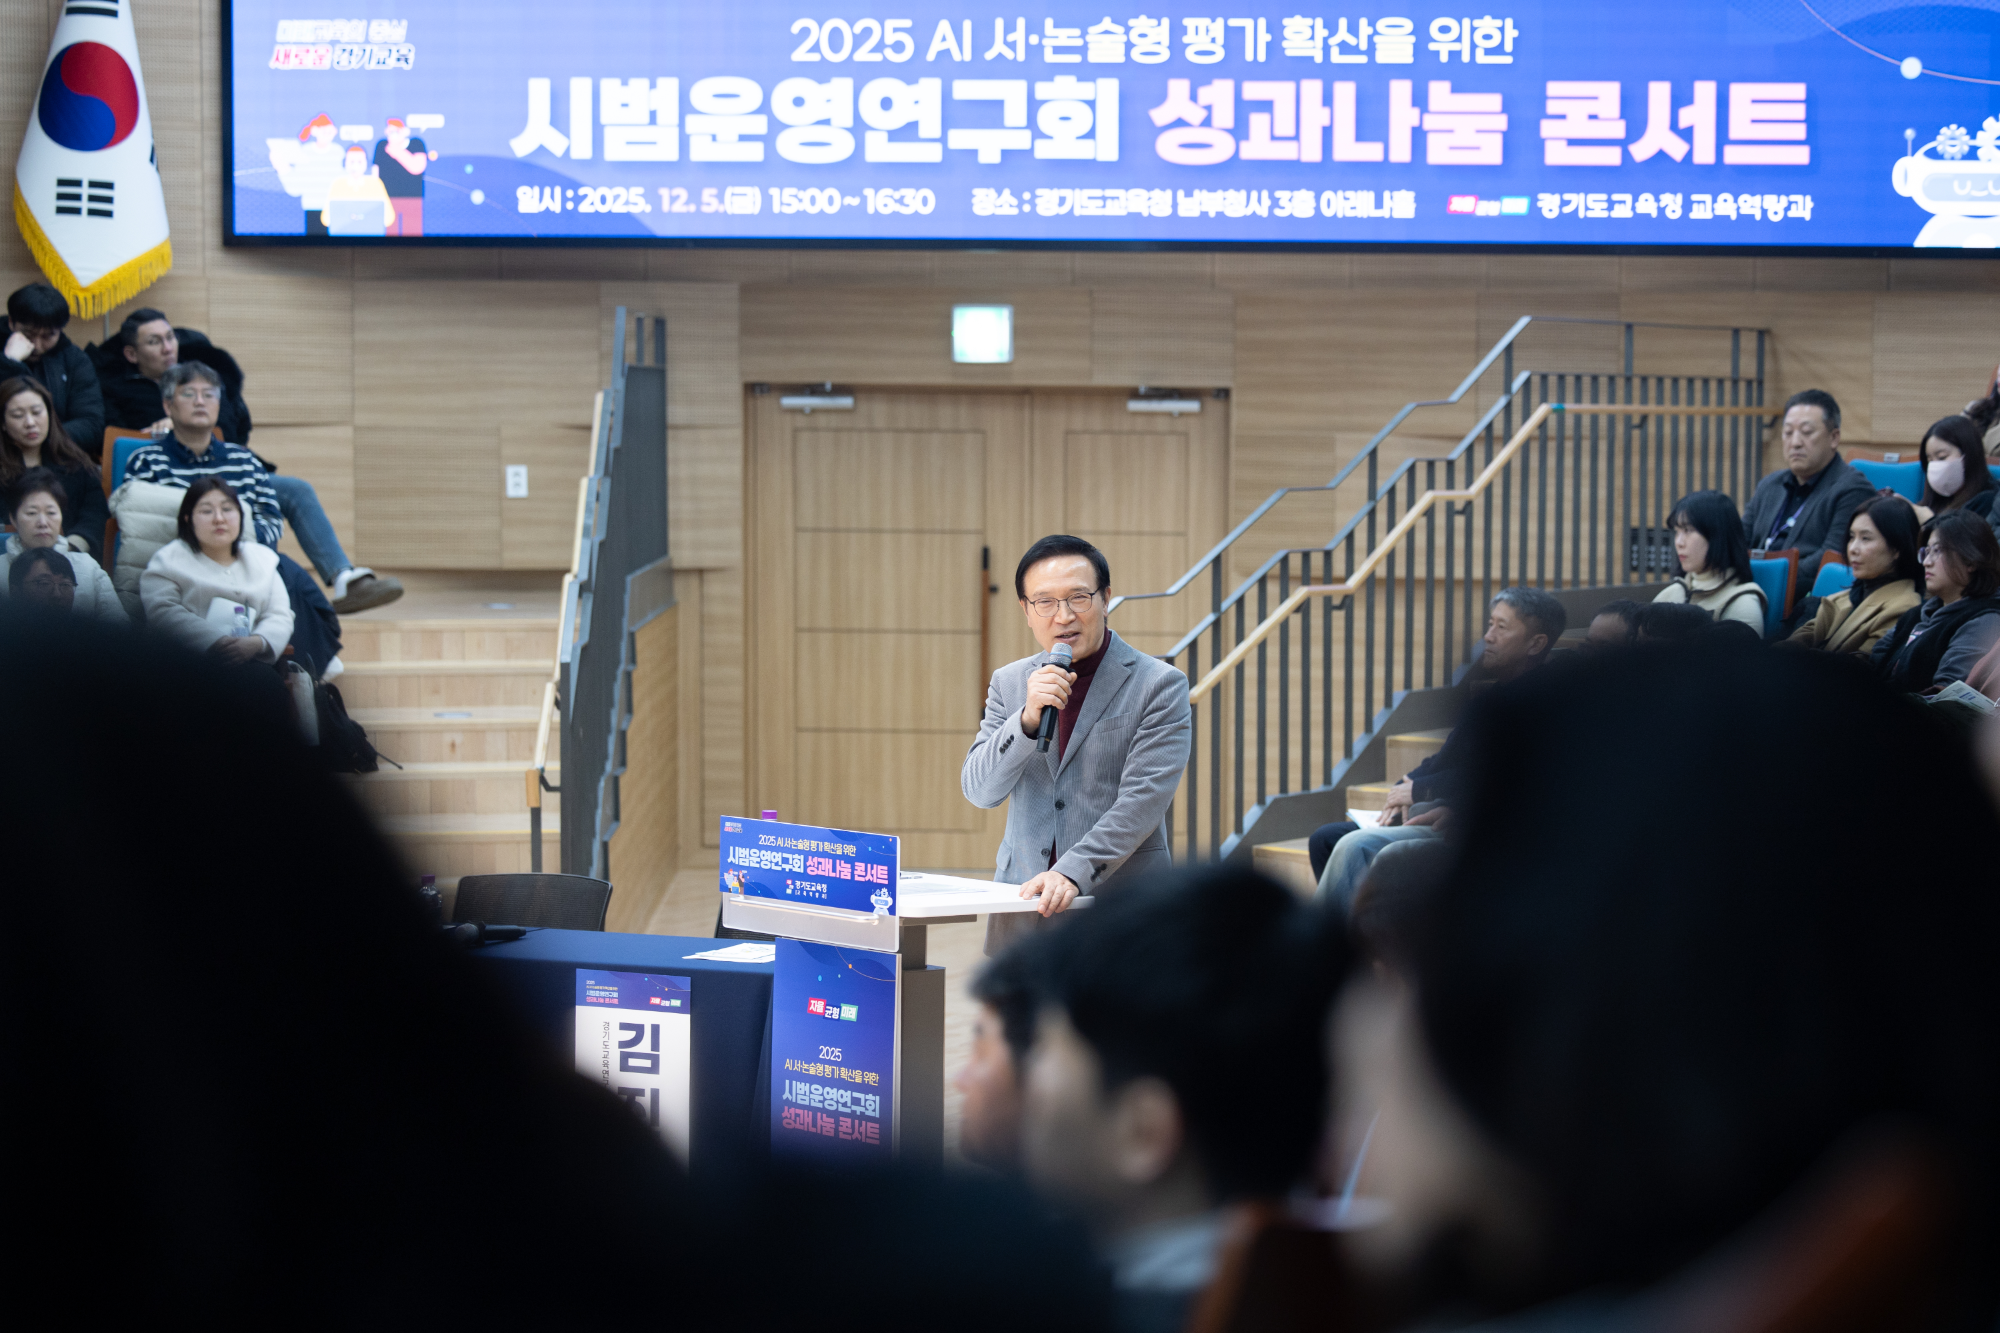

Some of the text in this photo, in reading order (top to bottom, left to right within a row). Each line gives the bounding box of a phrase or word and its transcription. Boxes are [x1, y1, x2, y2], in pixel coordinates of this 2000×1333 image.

[790, 18, 915, 63] 2025
[926, 19, 972, 62] AI
[1182, 17, 1272, 64] 평가
[1282, 15, 1416, 64] 확산을
[1428, 15, 1519, 64] 위한
[509, 75, 1809, 166] 시범운영연구회 성과나눔 콘서트
[578, 186, 652, 214] 2025.
[1035, 188, 1173, 217] 경기도교육청
[1536, 193, 1684, 220] 경기도교육청
[1688, 192, 1815, 222] 교육역량과
[758, 834, 776, 847] 2025
[810, 840, 823, 853] 평가
[843, 844, 857, 857] 위한
[727, 846, 889, 885] 시범운영연구회 성과나눔 콘서트
[809, 999, 857, 1019] 자율 균형 미래
[818, 1045, 842, 1062] 2025
[784, 1058, 793, 1071] AI
[824, 1065, 839, 1079] 평가
[840, 1067, 863, 1084] 확산을
[863, 1070, 879, 1086] 위한
[782, 1079, 880, 1118] 시범운영연구회
[781, 1106, 880, 1145] 성과나눔 콘서트
